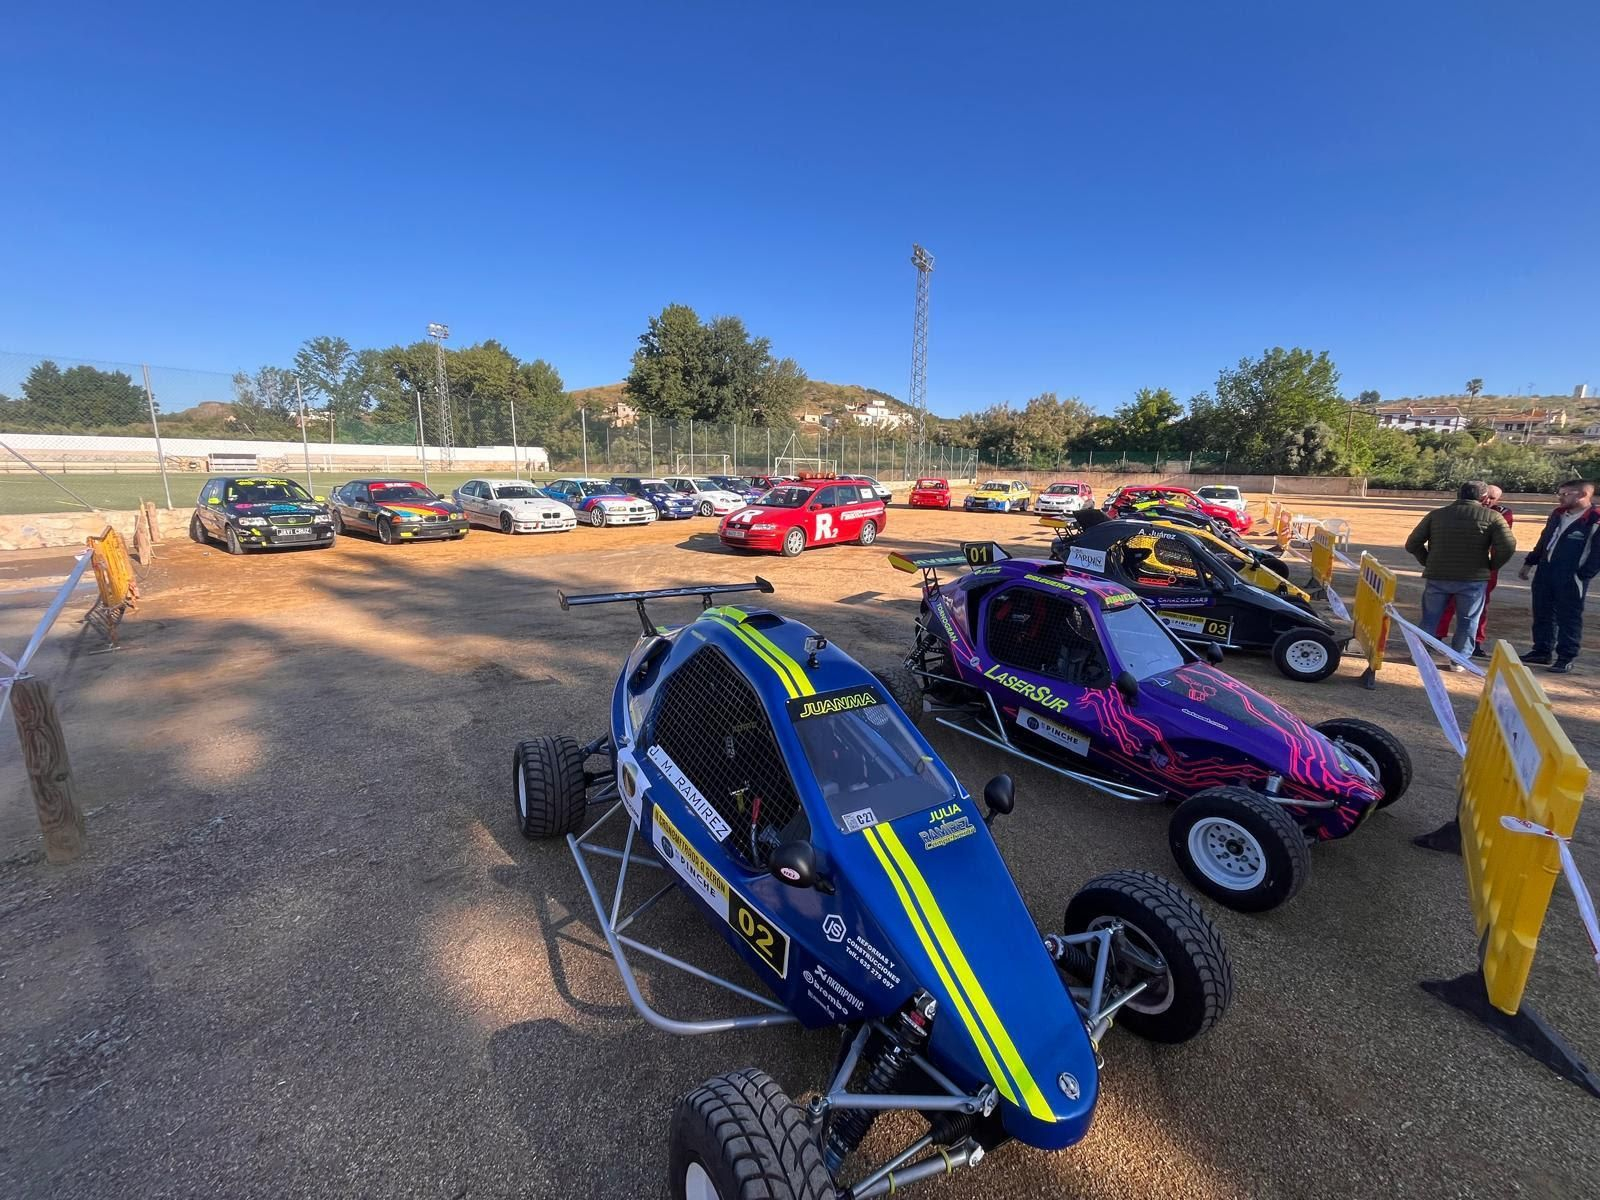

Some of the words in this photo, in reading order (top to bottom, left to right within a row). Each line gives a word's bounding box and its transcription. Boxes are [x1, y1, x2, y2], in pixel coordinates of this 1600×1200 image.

[730, 509, 764, 523] R
[970, 546, 987, 563] 01
[937, 602, 959, 643] TORNOGRAN
[1175, 620, 1197, 628] PINCHE
[1208, 622, 1227, 635] 03
[800, 692, 876, 718] JUANMA
[1046, 724, 1079, 744] PINCHE
[650, 747, 658, 760] J.
[660, 760, 672, 777] M.
[675, 776, 728, 838] RAMIREZ
[929, 803, 962, 823] JULIA
[680, 855, 717, 899] PINCHE
[738, 907, 774, 958] 02
[846, 937, 901, 984] CONSTRUCCIONES
[857, 935, 889, 965] REFORMAS
[890, 960, 896, 969] Y
[859, 959, 871, 971] 635
[870, 968, 882, 981] 275
[826, 976, 865, 1011] AKRAPOVIC
